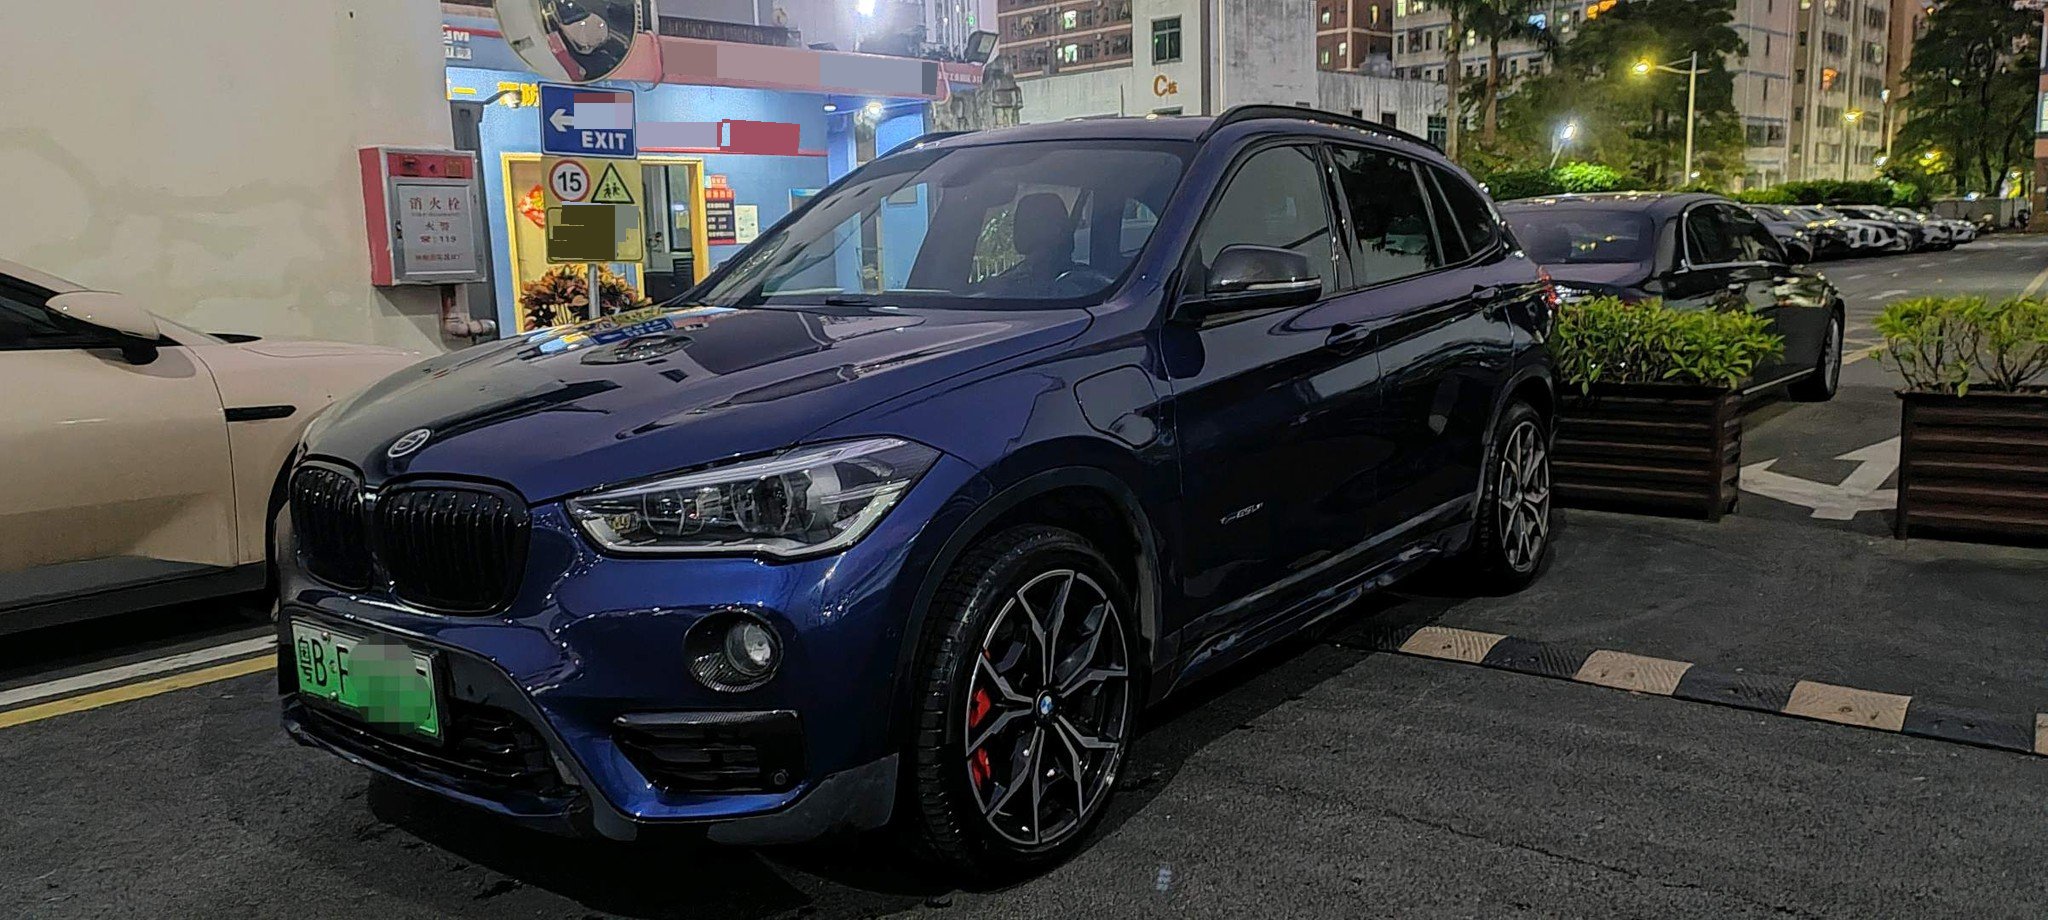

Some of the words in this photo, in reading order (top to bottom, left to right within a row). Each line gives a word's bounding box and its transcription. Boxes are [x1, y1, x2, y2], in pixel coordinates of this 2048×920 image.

[581, 131, 627, 150] EXIT
[557, 172, 582, 192] 15
[409, 197, 461, 210] 消火栓
